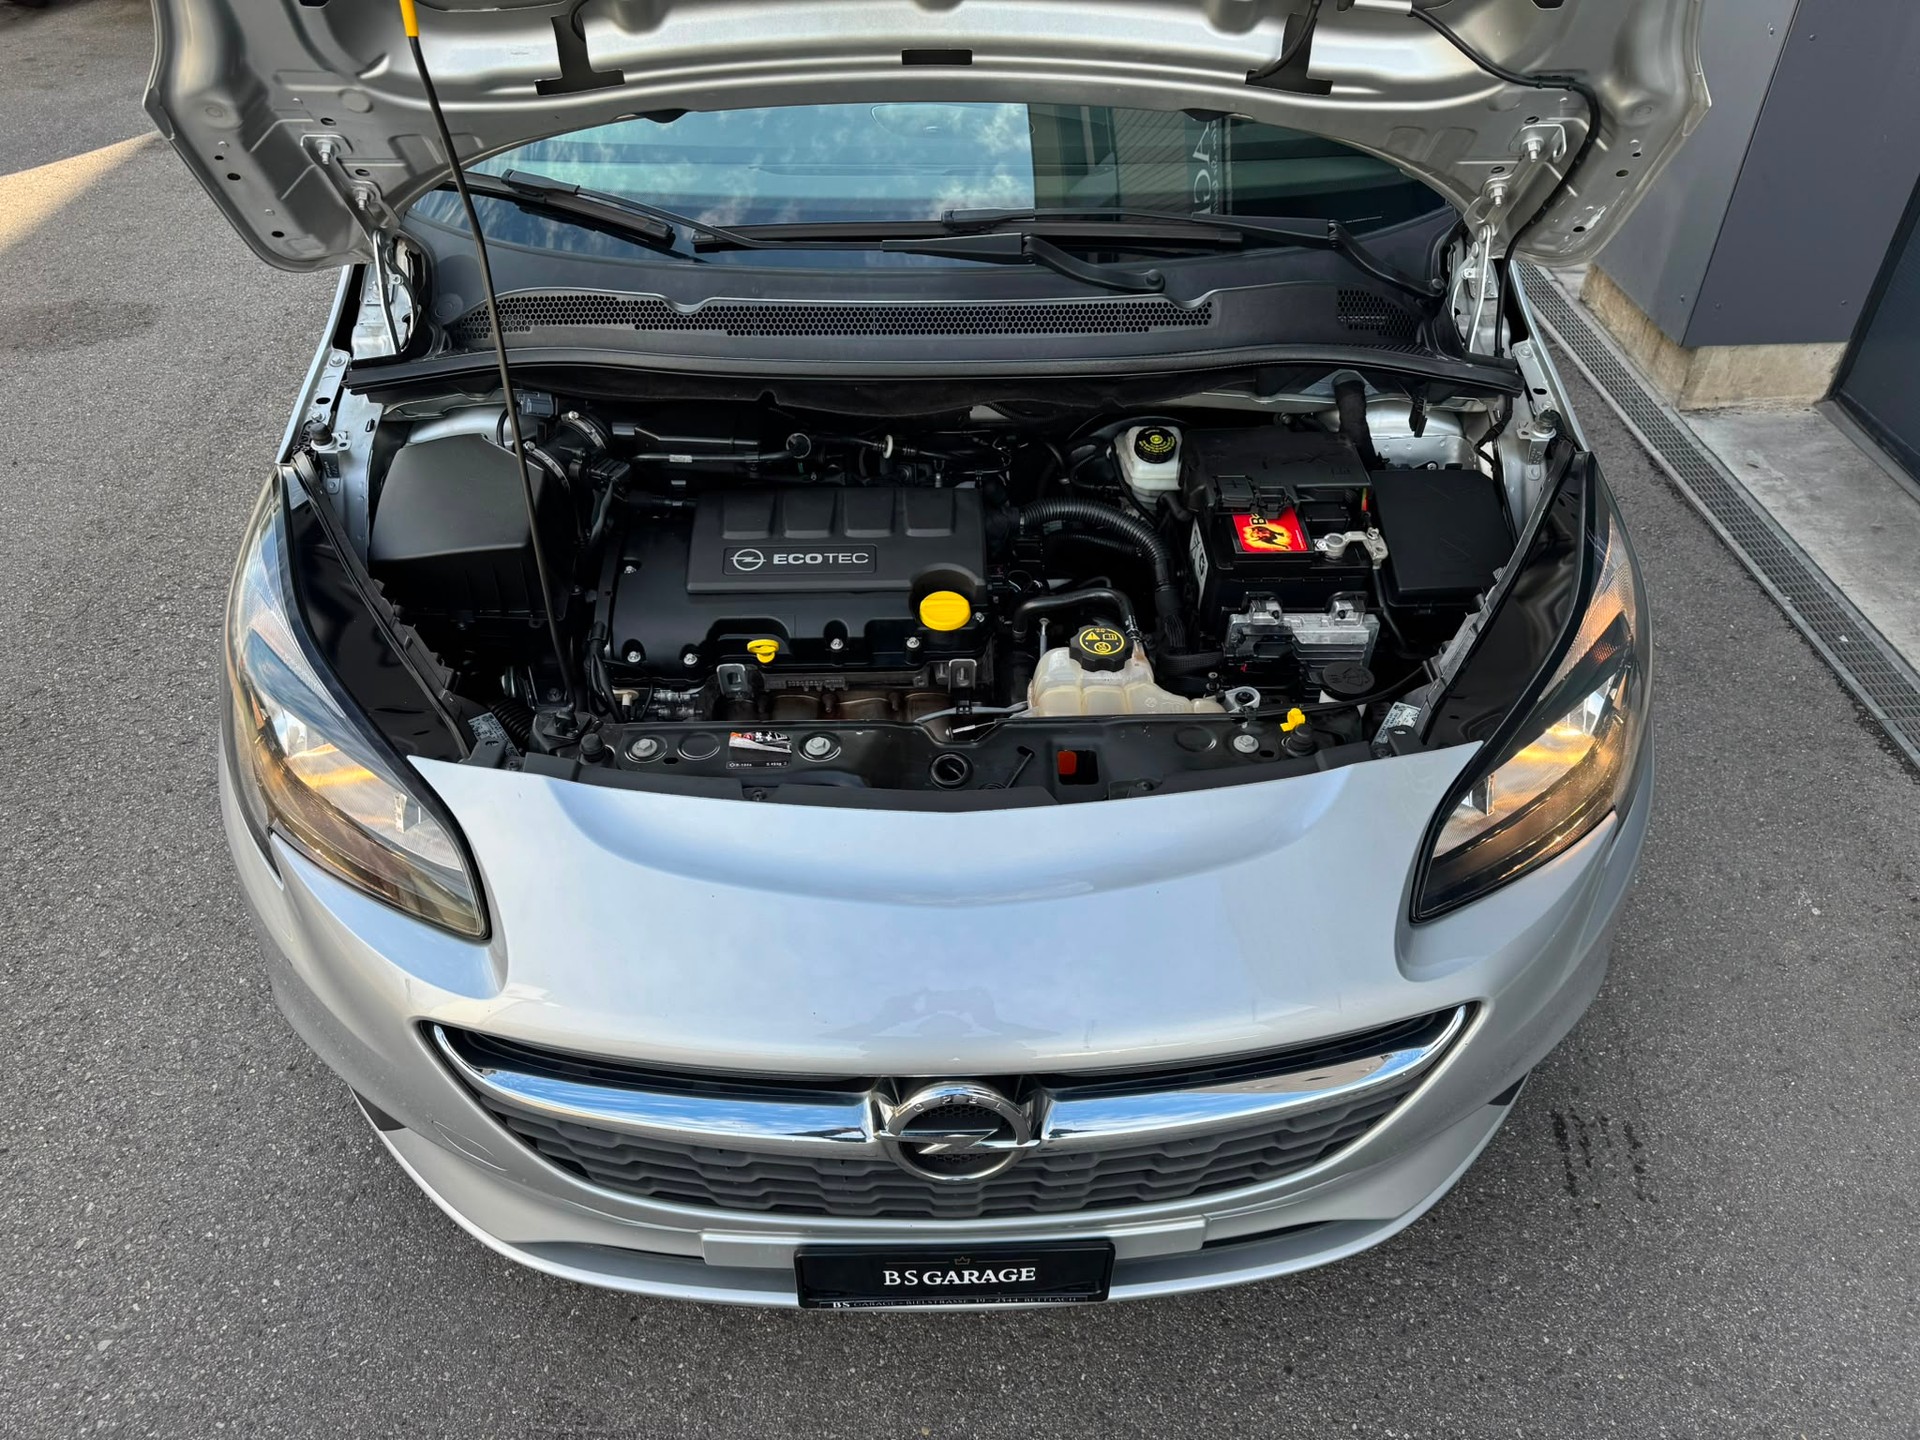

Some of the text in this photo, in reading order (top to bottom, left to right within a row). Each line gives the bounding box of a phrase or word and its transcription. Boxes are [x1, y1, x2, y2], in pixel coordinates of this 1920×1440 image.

[772, 552, 869, 565] ECOTEC
[913, 1095, 1002, 1113] OPEL
[882, 1266, 1036, 1286] BS GARAGE
